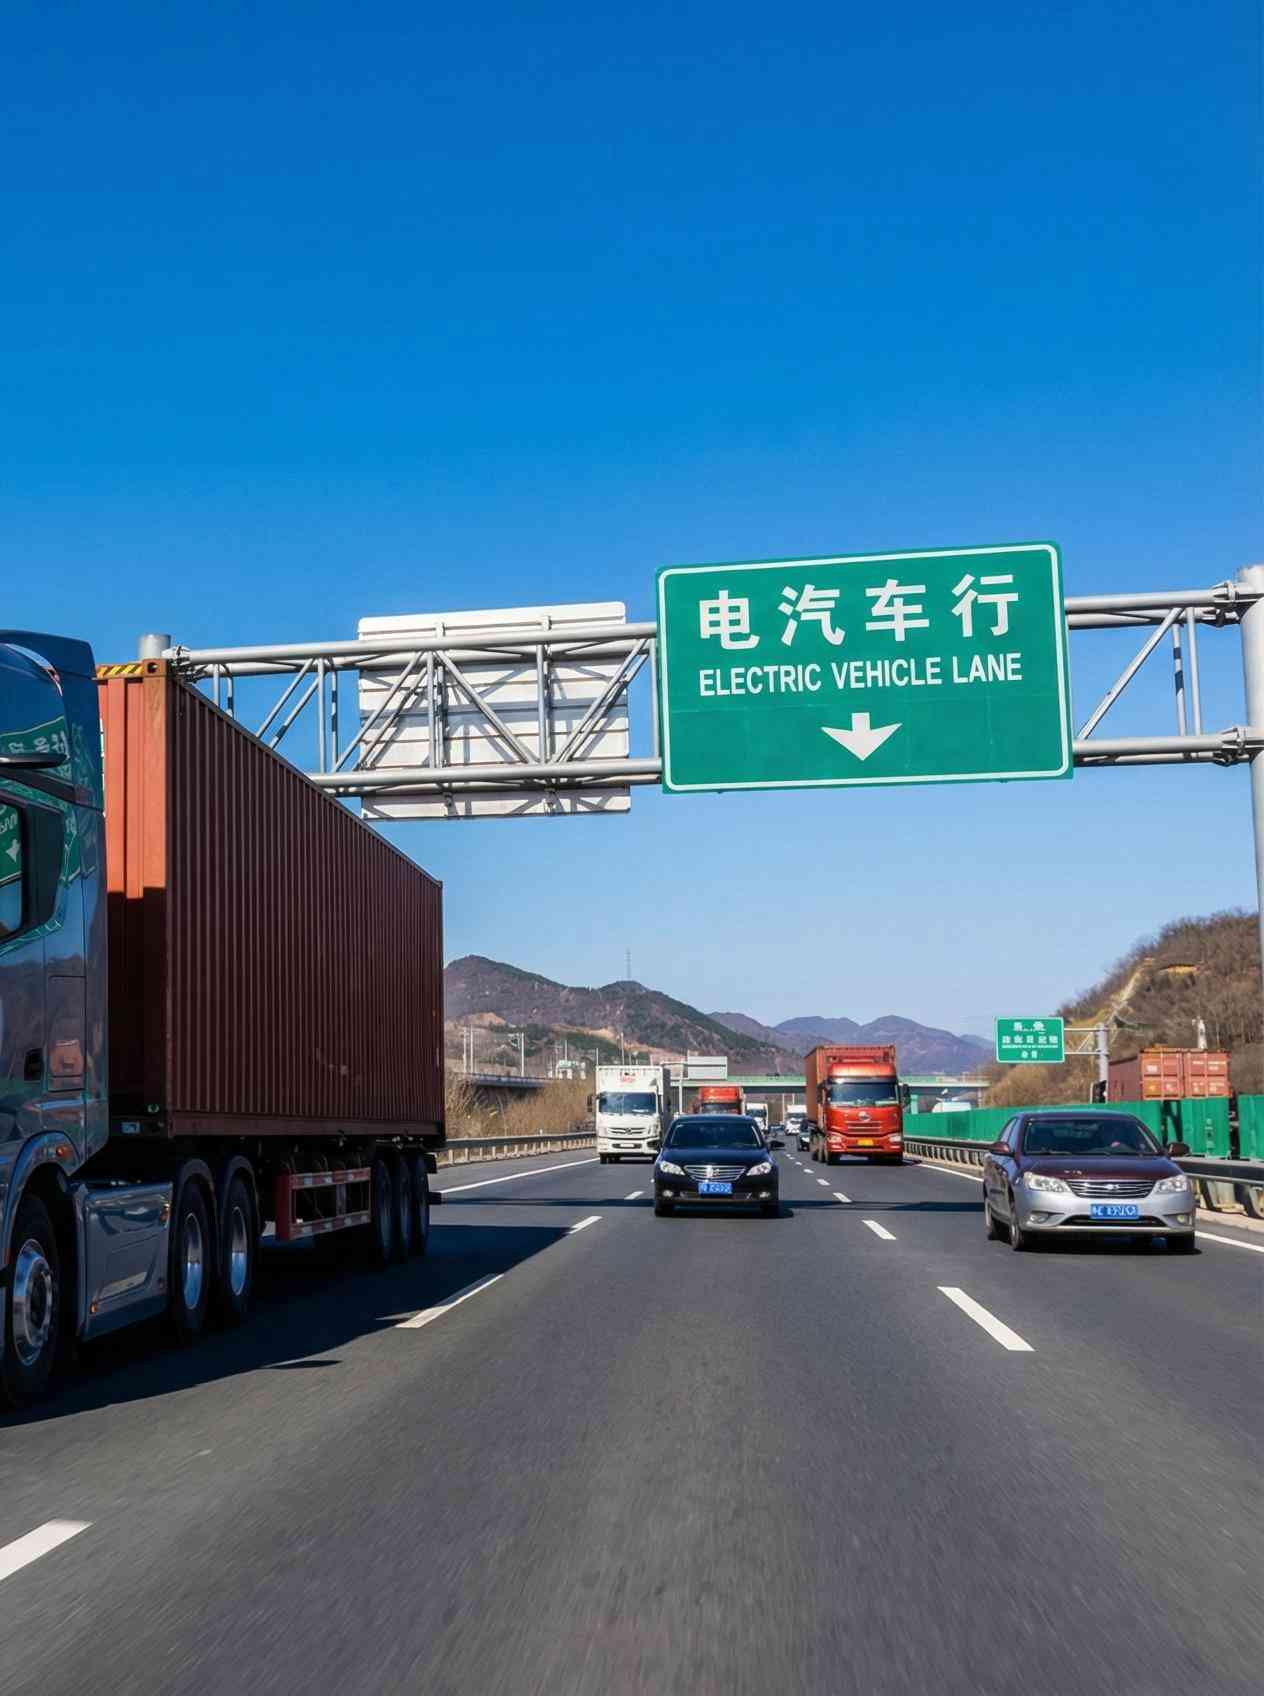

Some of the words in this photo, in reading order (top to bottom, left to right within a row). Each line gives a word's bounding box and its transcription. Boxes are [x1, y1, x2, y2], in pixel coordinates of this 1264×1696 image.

[698, 574, 1019, 651] 电汽车行
[699, 663, 823, 697] ELECTRIC
[831, 656, 943, 691] VEHICLE
[952, 652, 1023, 685] LANE
